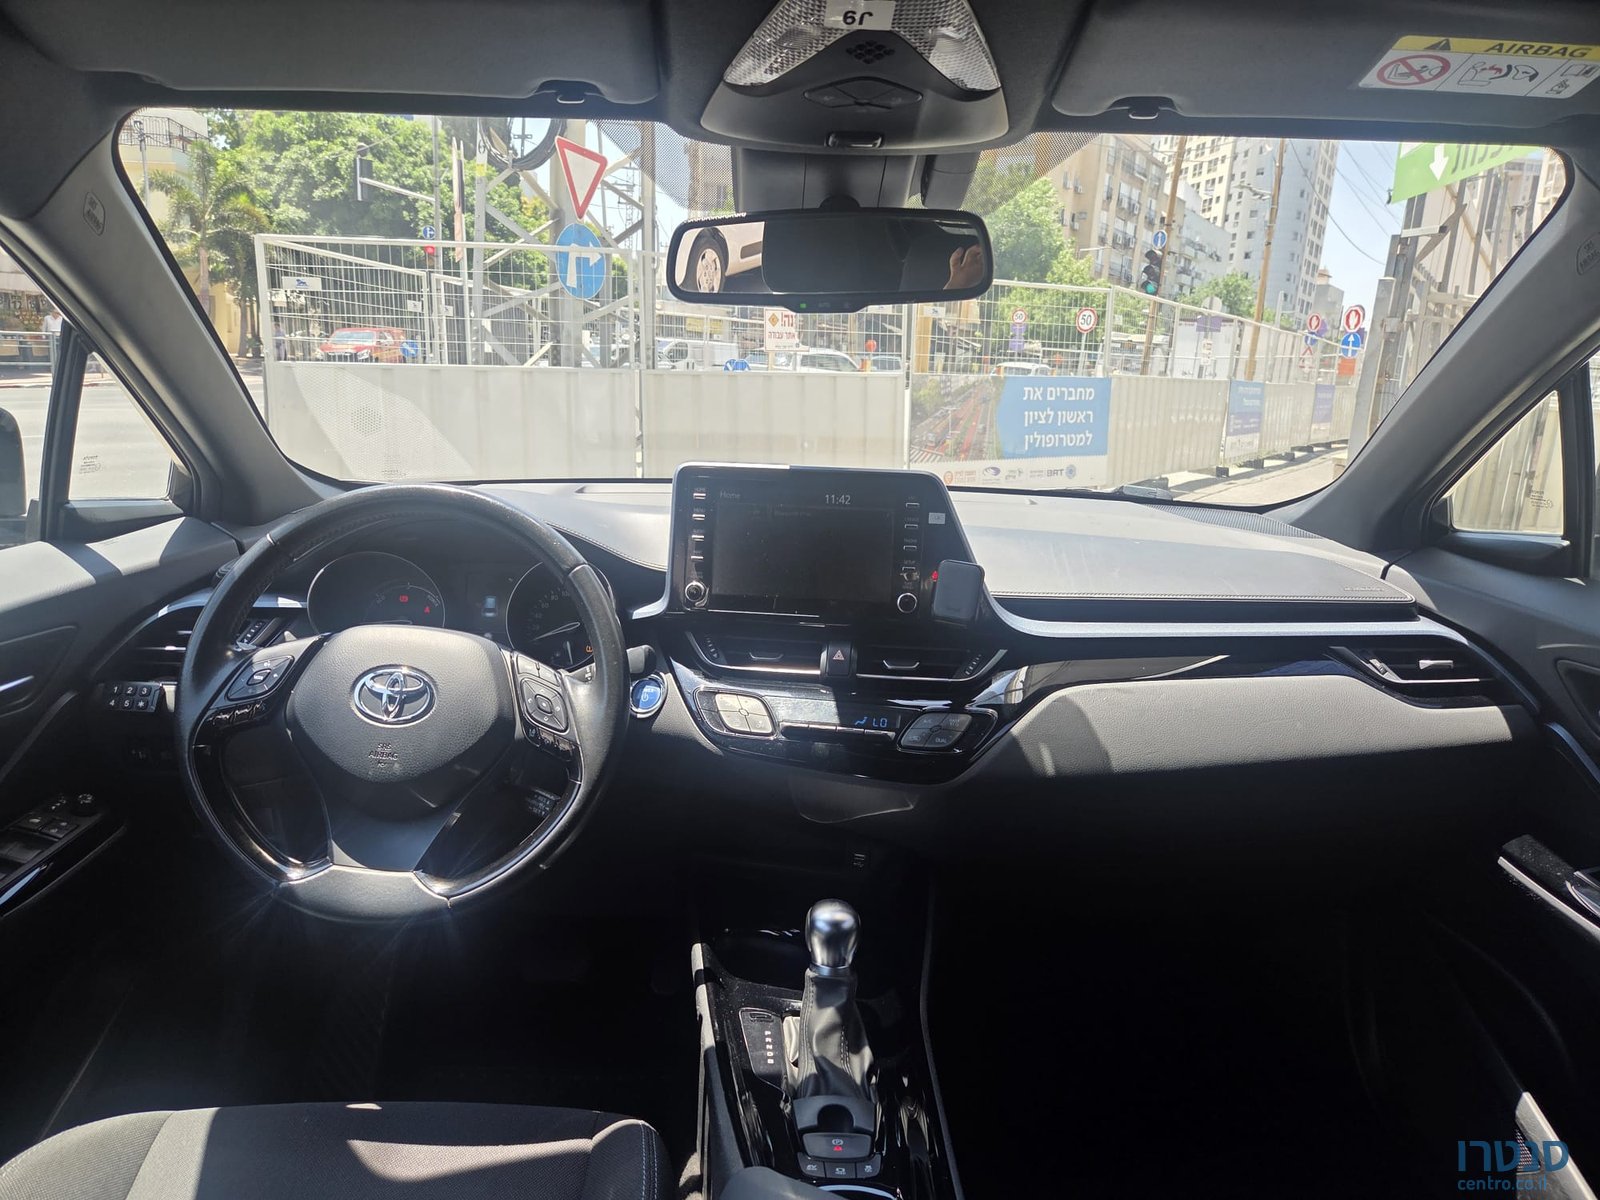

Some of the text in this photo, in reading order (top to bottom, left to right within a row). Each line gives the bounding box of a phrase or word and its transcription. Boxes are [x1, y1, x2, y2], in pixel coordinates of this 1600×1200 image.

[1484, 42, 1593, 58] AIRBAG
[1079, 314, 1092, 326] 50
[1023, 386, 1095, 401] מחברים את
[1024, 406, 1094, 428] ראשון לציון
[1024, 429, 1093, 452] למטרופולין
[825, 494, 851, 505] 11:42
[113, 686, 148, 695] 1 2 3
[124, 699, 130, 707] 5
